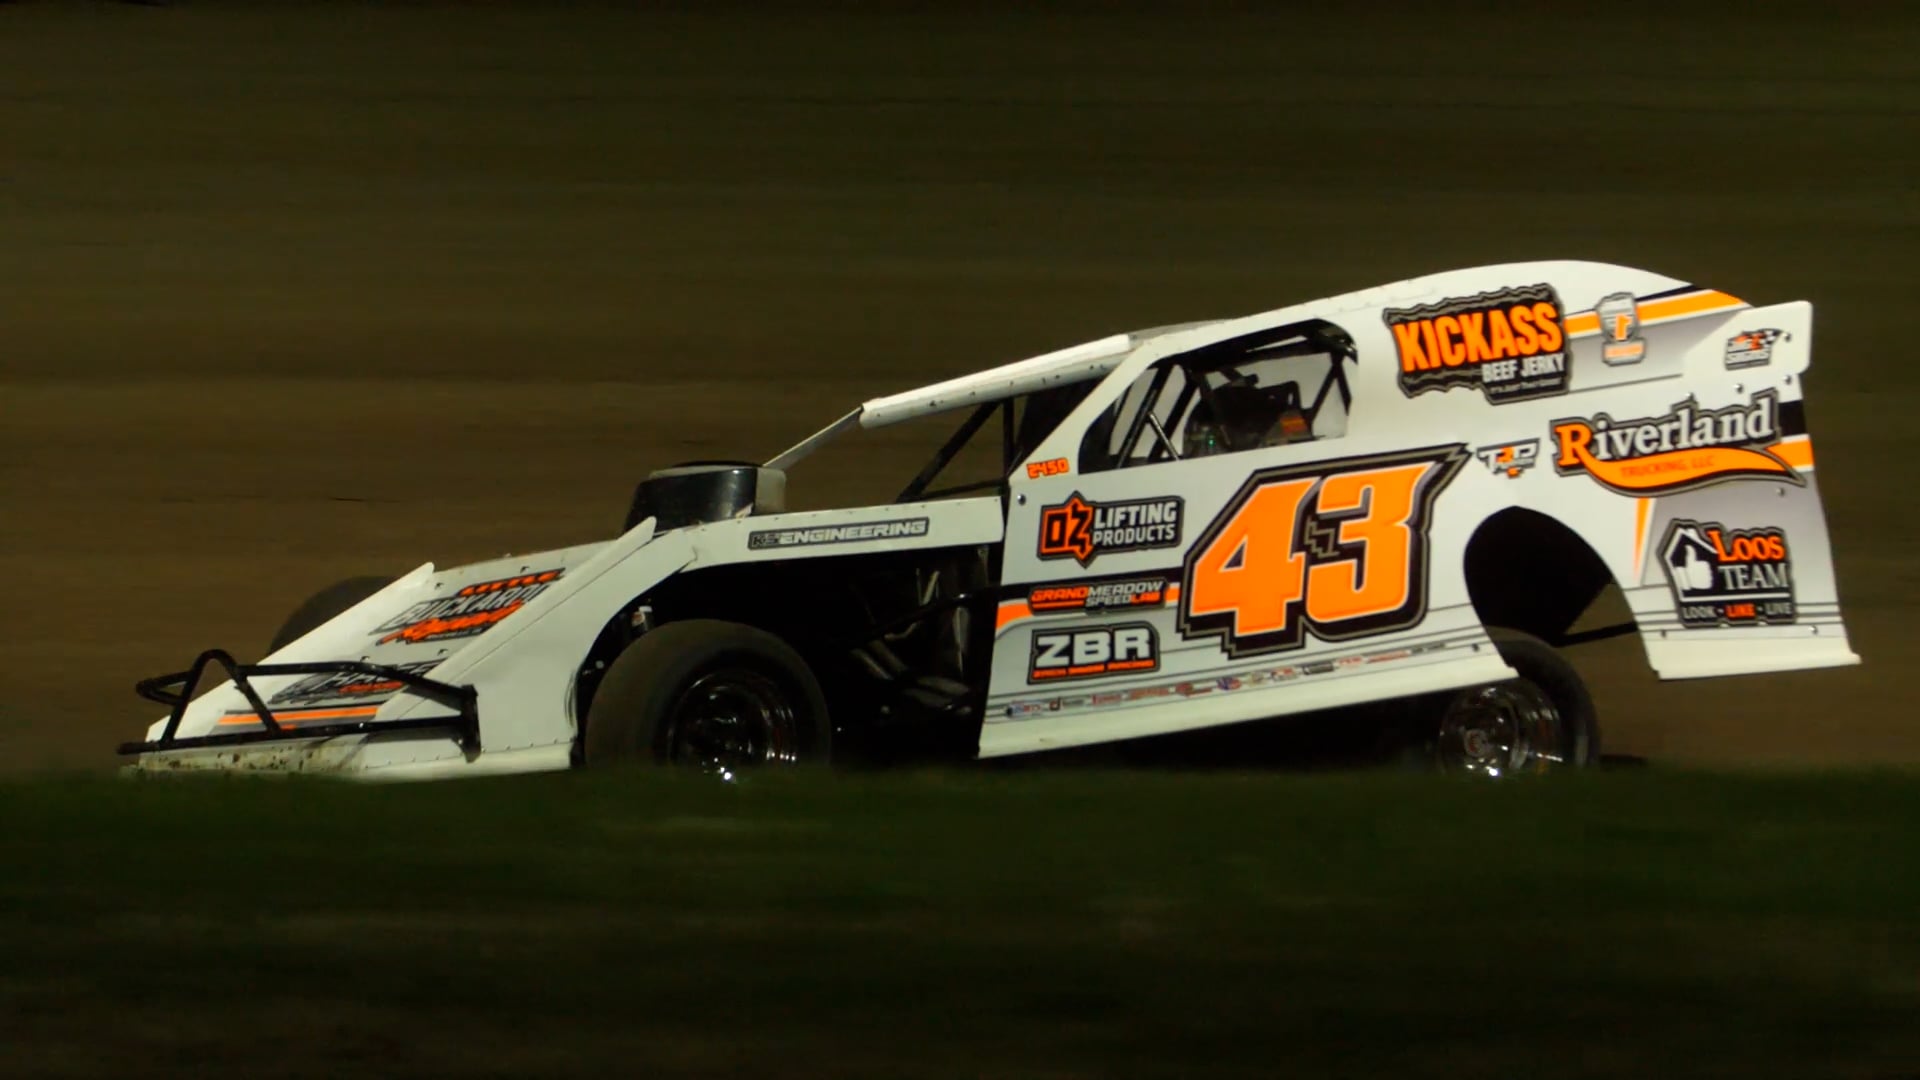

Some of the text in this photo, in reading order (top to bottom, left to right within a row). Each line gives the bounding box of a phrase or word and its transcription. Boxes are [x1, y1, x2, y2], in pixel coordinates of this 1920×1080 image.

[1392, 302, 1562, 372] KICKASS
[1482, 353, 1565, 383] BEEF JERKY
[1554, 397, 1774, 466] Riverland
[1026, 457, 1069, 479] 2450
[1094, 501, 1177, 529] LIFTING
[1093, 523, 1175, 545] PRODUCTS
[1190, 463, 1432, 637] 43
[1718, 562, 1789, 590] TEAM
[1035, 627, 1151, 668] ZBR
